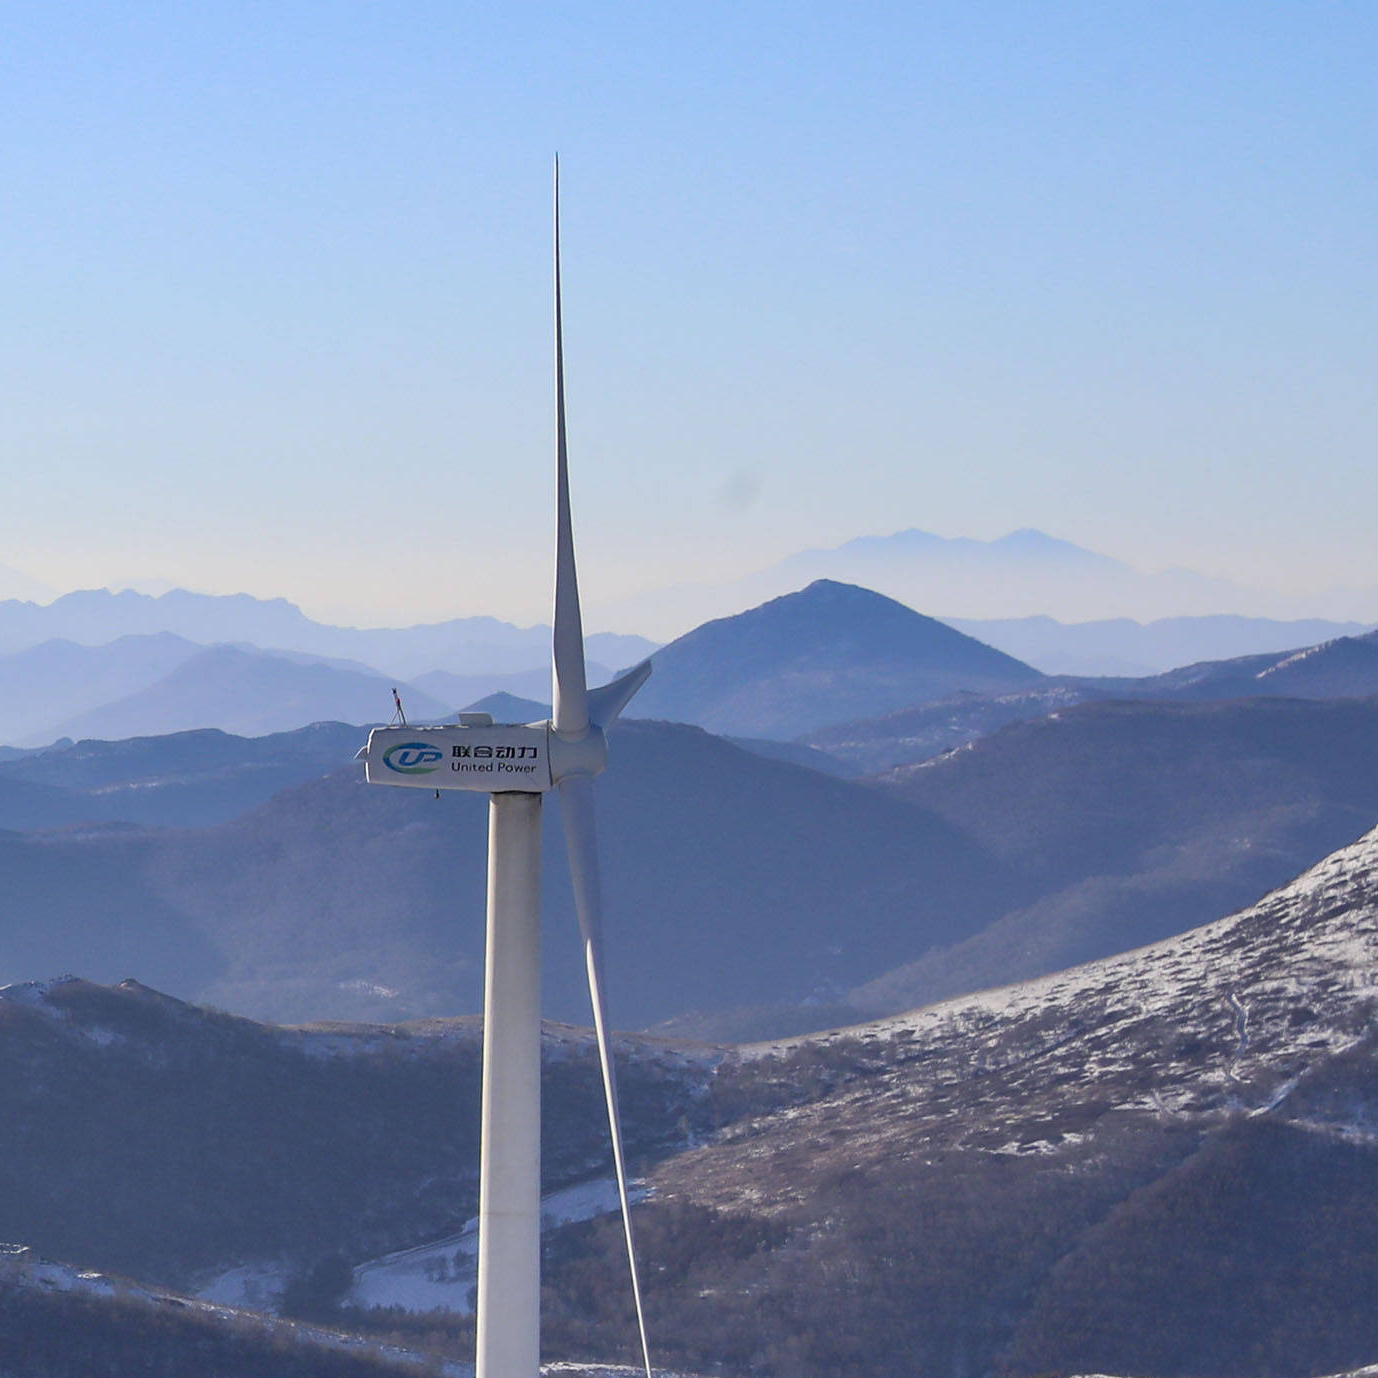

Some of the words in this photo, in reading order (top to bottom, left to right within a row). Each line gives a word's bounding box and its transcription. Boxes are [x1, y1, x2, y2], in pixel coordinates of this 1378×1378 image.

[452, 745, 538, 759] 联合动力
[451, 762, 493, 772] United
[498, 762, 537, 773] Power
